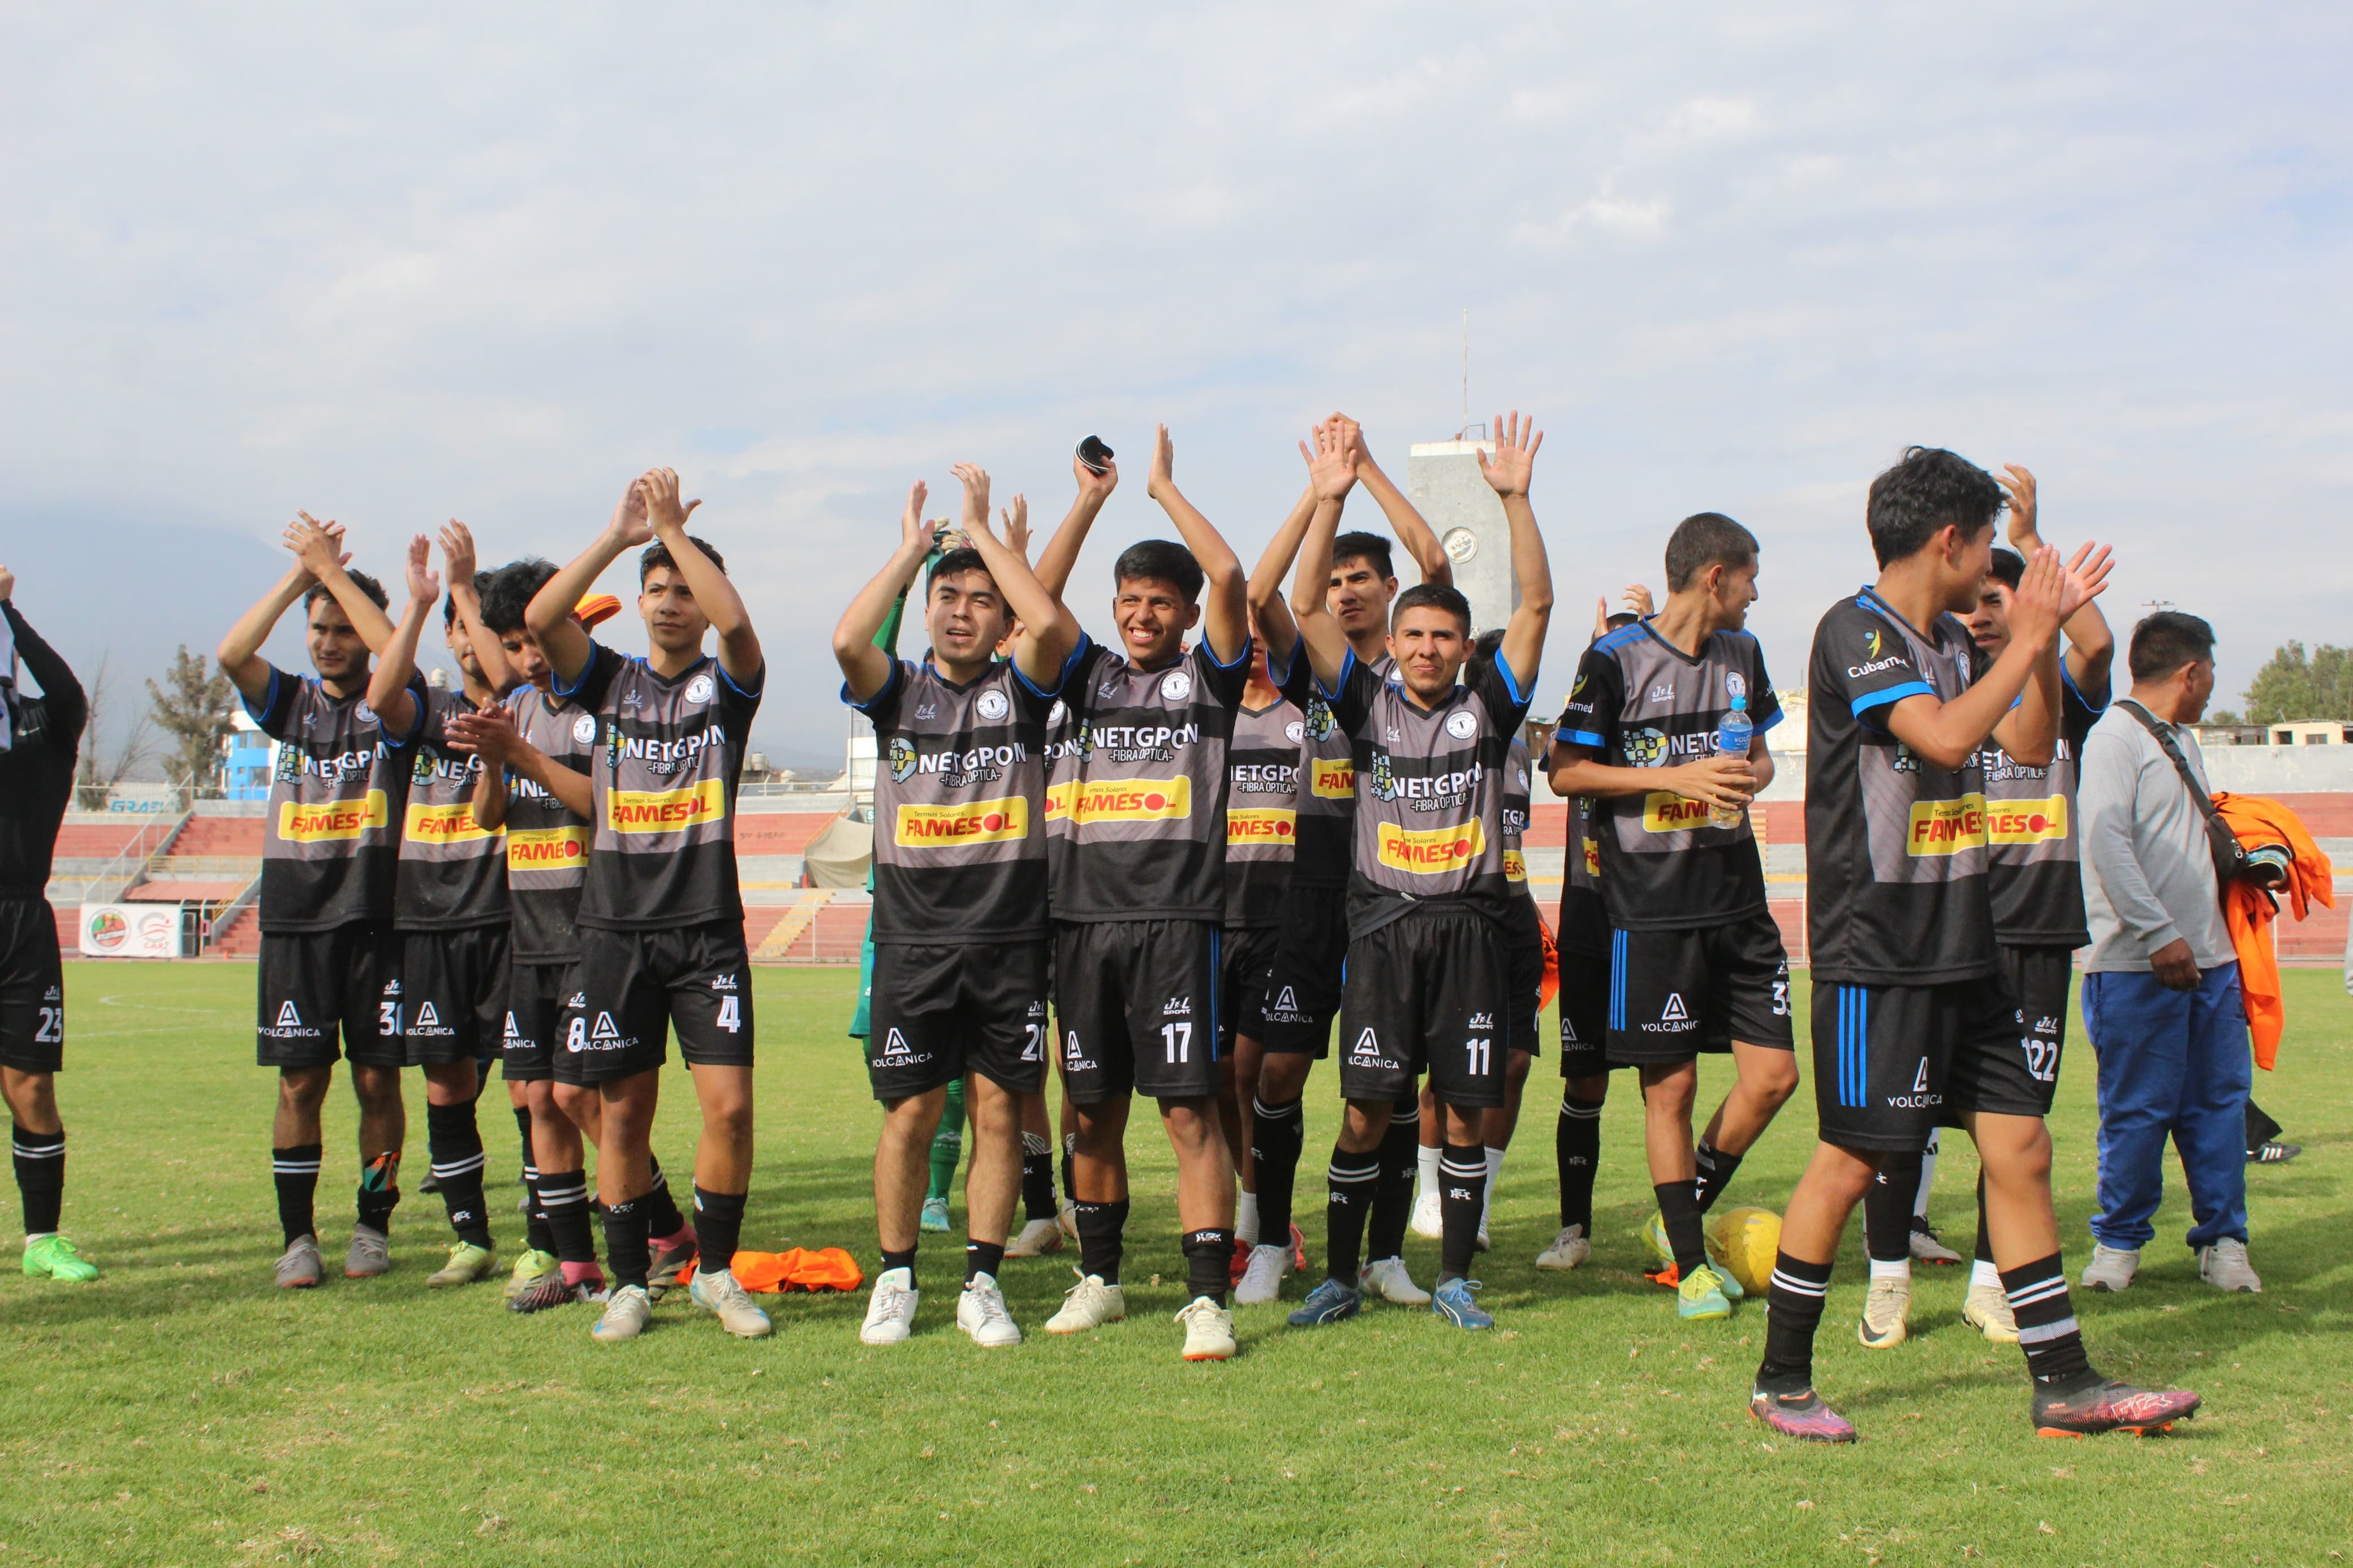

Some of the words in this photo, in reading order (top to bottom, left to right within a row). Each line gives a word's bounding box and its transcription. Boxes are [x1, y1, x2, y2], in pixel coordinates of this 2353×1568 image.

[1092, 723, 1199, 750] NETGPON
[1076, 792, 1176, 814] FAMESOL
[905, 812, 1018, 837] FAMESOL
[35, 1007, 62, 1043] 23
[717, 995, 740, 1033] 4
[1161, 1022, 1192, 1064] 17
[1466, 1038, 1490, 1075] 11
